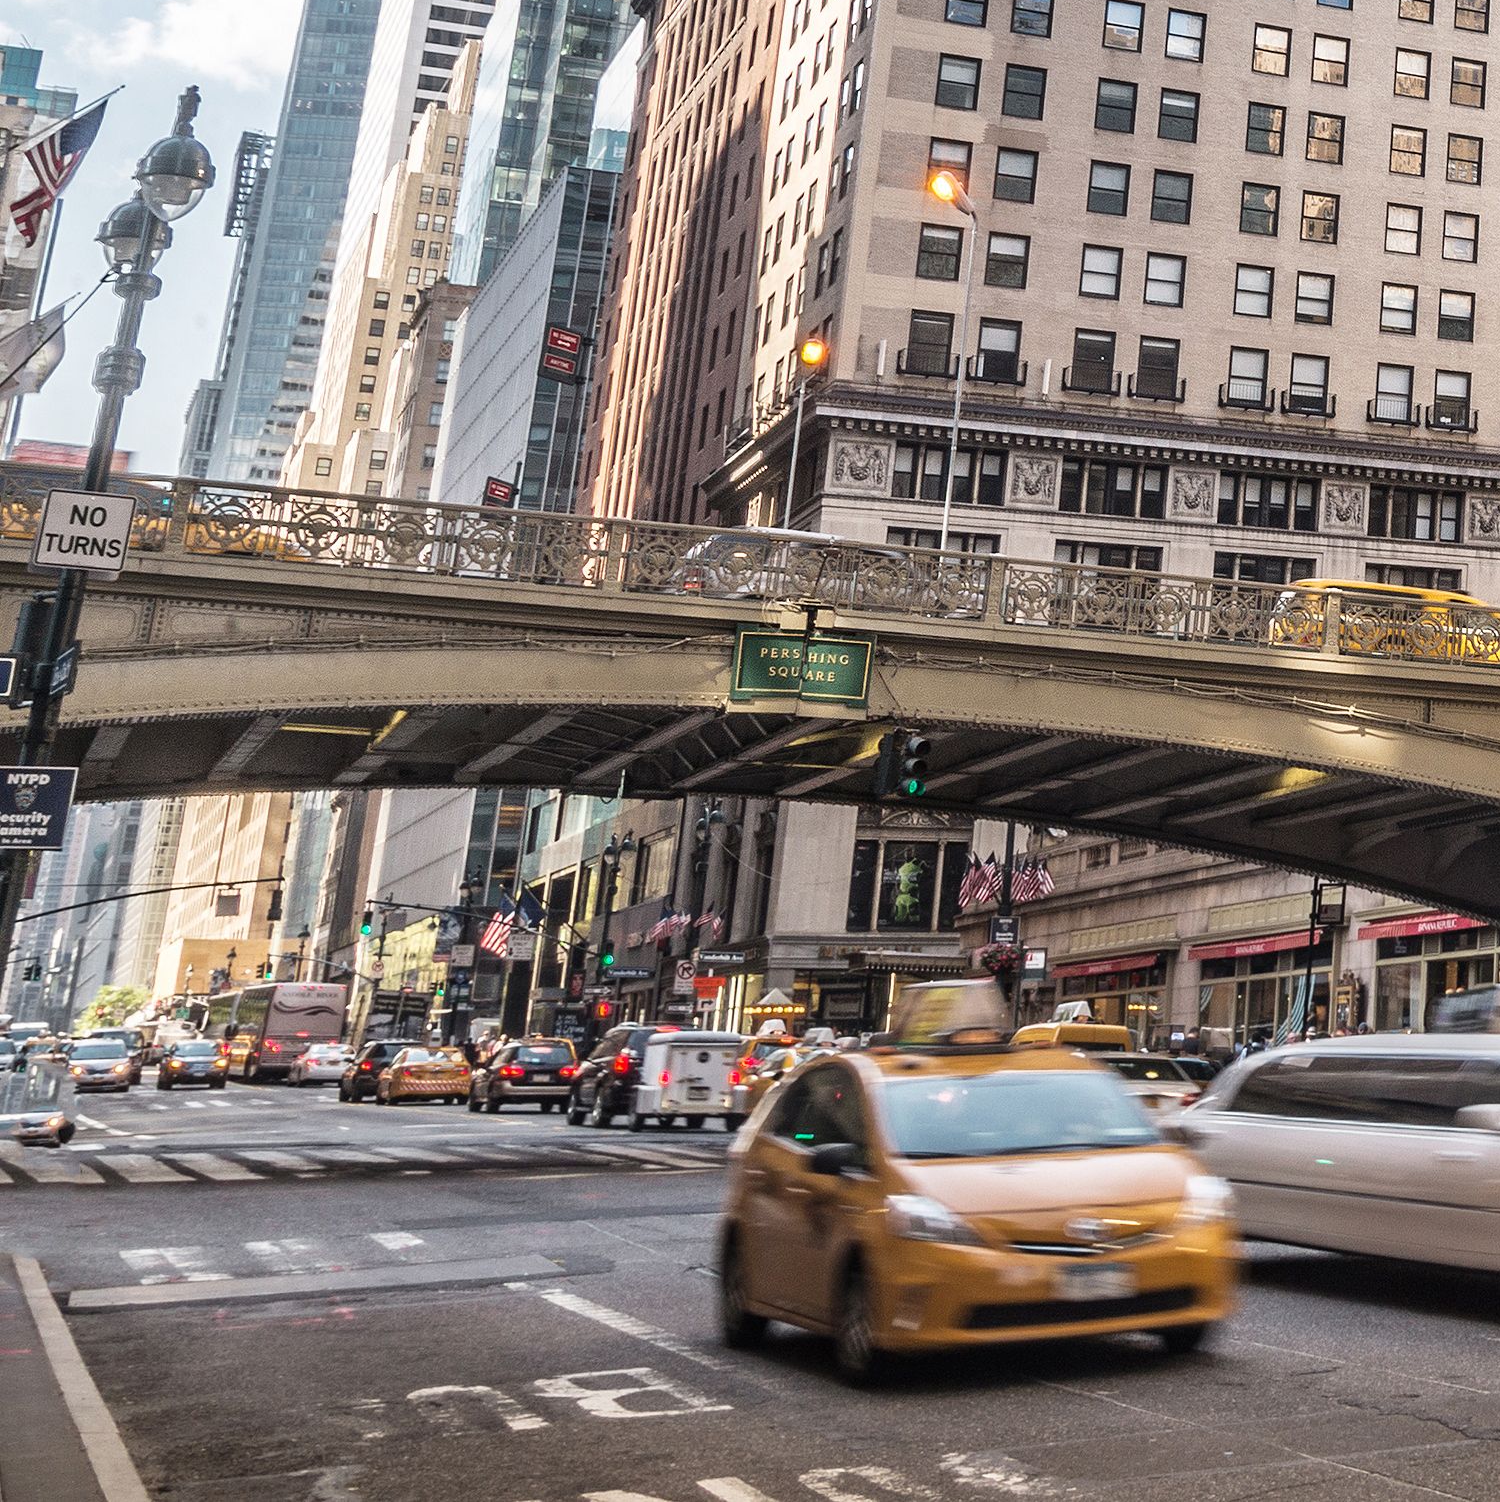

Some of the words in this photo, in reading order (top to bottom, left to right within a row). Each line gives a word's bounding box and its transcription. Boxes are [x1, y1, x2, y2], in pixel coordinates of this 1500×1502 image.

[69, 504, 107, 527] NO
[45, 533, 122, 558] TURNS
[760, 647, 849, 665] PERSHING
[768, 666, 836, 682] SQUARE
[7, 774, 51, 785] NYPD
[0, 811, 52, 826] ecurity
[0, 827, 48, 836] amera
